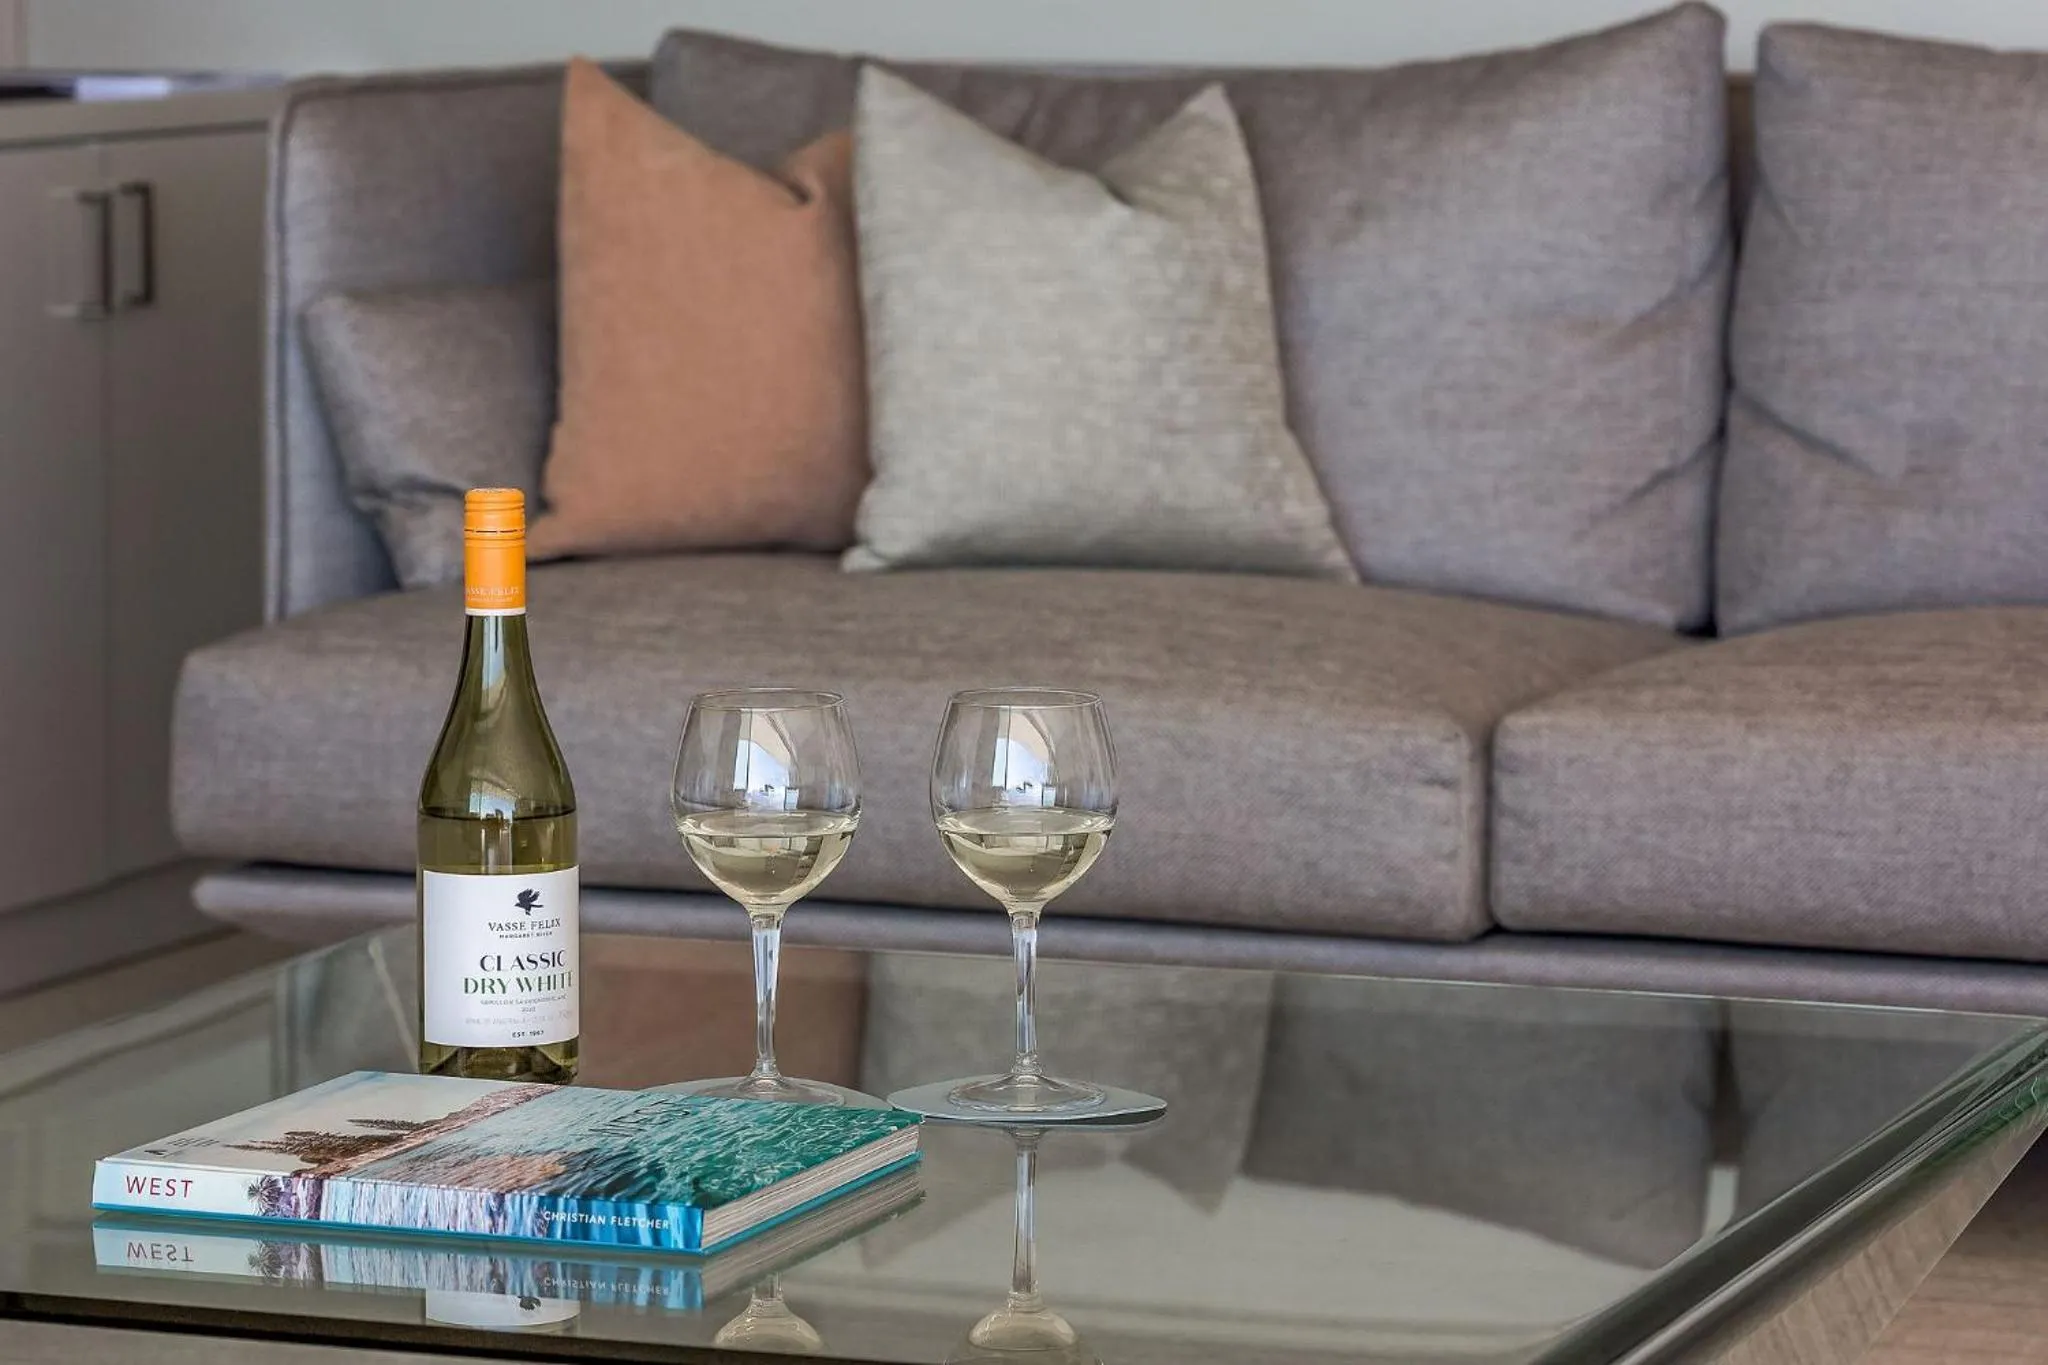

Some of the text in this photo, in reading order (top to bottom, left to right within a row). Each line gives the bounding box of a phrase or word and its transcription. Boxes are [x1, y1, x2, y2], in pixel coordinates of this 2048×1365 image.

[488, 917, 561, 932] VASSE FELIX
[479, 950, 567, 972] CLASSIC
[463, 976, 510, 995] DRY
[125, 1175, 194, 1198] WEST
[543, 1210, 670, 1230] CHRISTIAN FLETCHER
